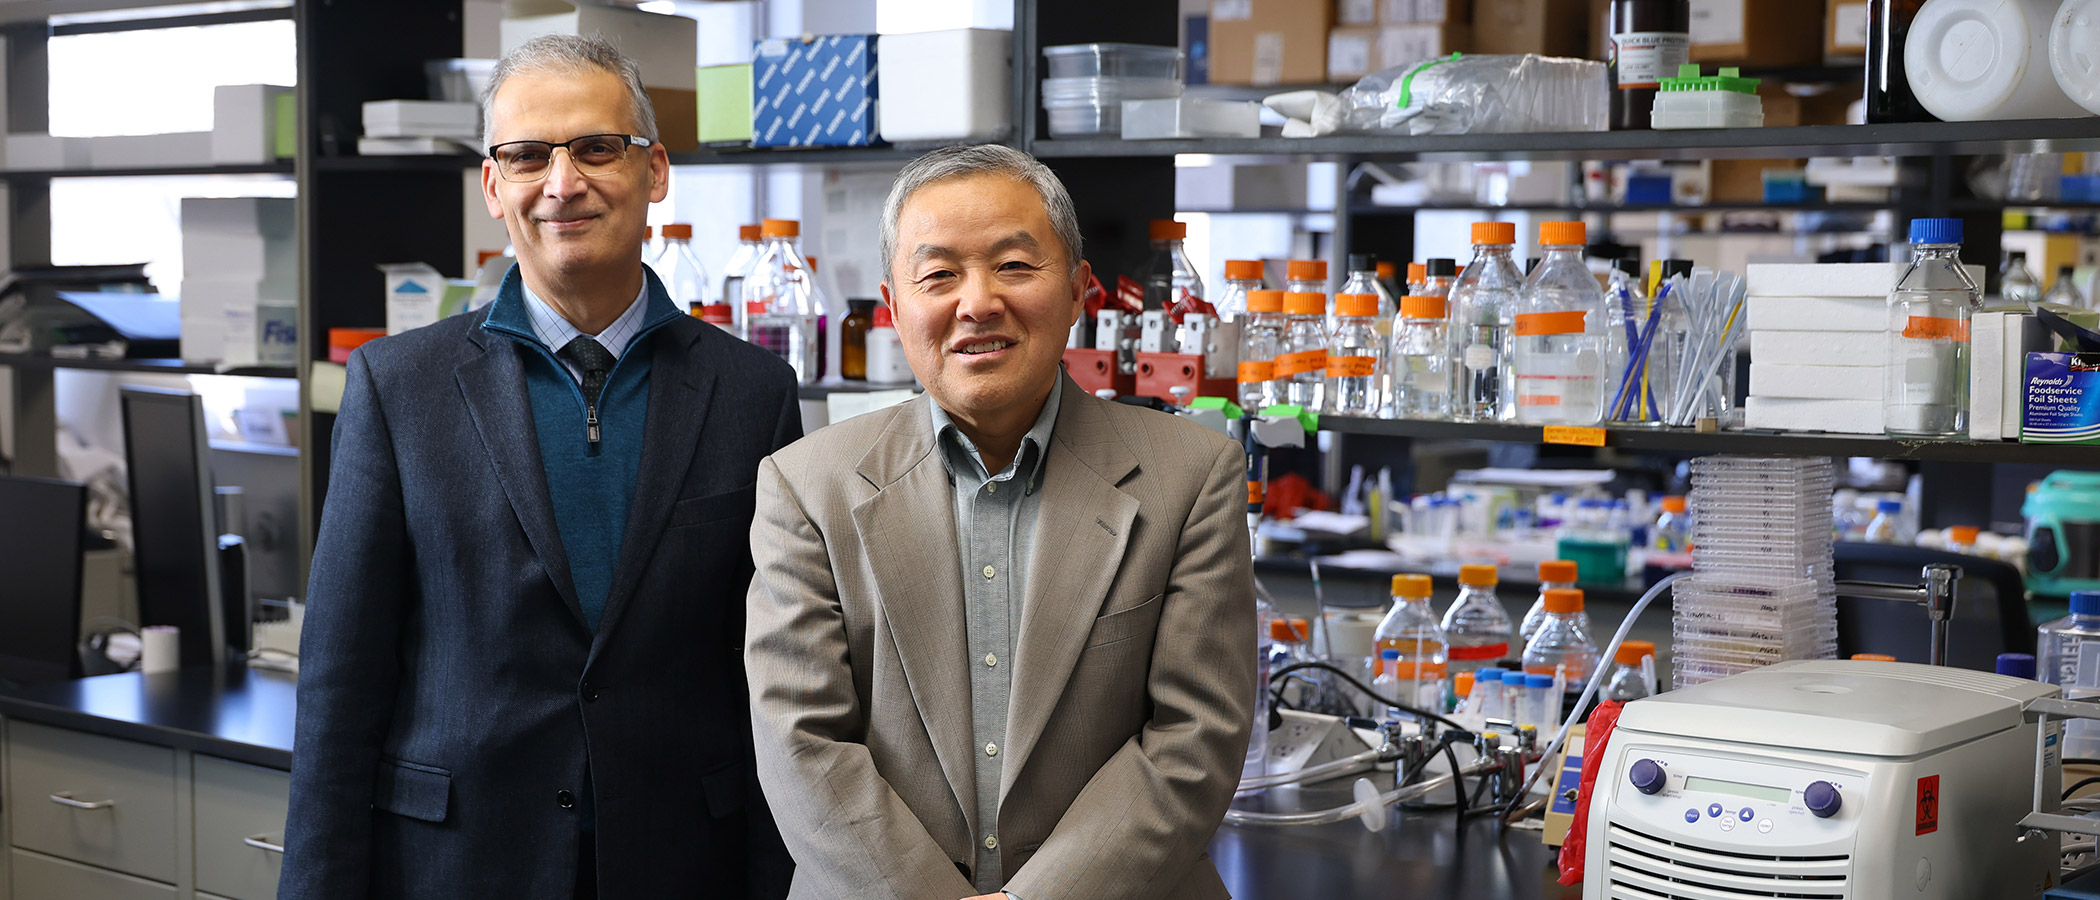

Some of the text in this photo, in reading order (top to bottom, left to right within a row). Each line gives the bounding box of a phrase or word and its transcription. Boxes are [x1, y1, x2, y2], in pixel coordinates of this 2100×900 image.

[757, 62, 778, 90] QIAGEN
[820, 53, 842, 82] QIAGEN
[771, 81, 792, 110] QIAGEN
[834, 73, 857, 103] QIAGEN
[786, 101, 808, 130] QIAGEN
[2029, 386, 2083, 395] Foodservice
[2030, 376, 2063, 387] Reynolds
[2029, 395, 2078, 404] Foil Sheets
[2057, 404, 2081, 413] Quality
